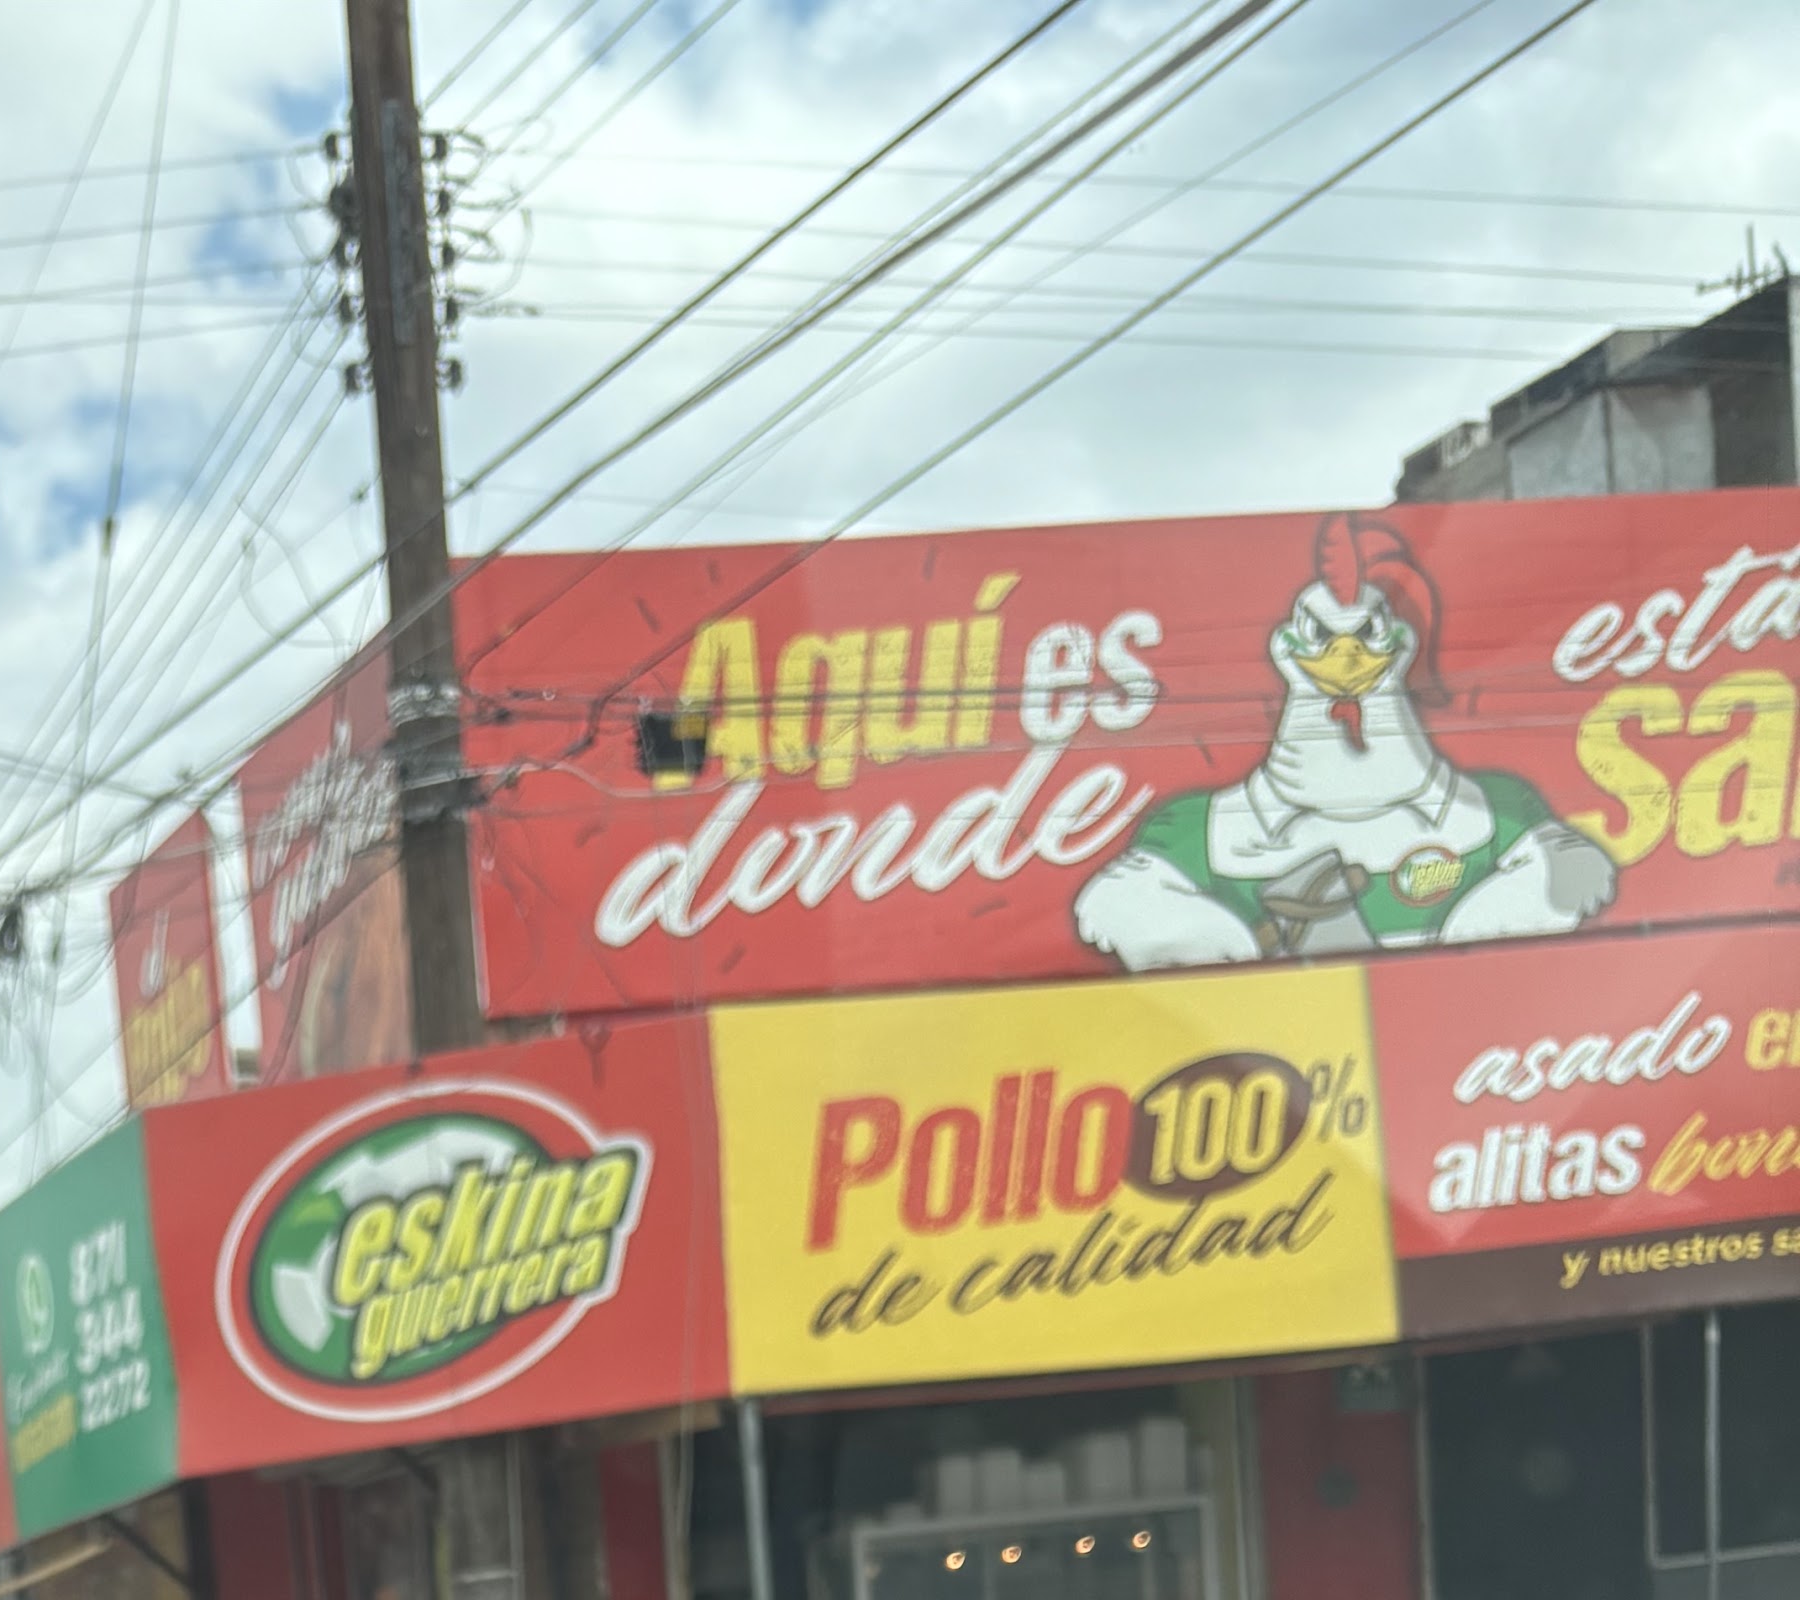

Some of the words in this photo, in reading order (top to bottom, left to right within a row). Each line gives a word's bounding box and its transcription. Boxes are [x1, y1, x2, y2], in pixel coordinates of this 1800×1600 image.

[650, 570, 1022, 792] Aquí
[1018, 610, 1164, 744] es
[594, 740, 1156, 948] donde
[1566, 668, 1800, 868] sa
[1452, 988, 1732, 1104] asado
[1743, 1006, 1800, 1072] e
[332, 1153, 637, 1308] eskina
[804, 1067, 1134, 1255] Pollo
[1428, 1121, 1646, 1213] alitas
[1647, 1111, 1800, 1197] bon
[74, 1284, 145, 1375] 344
[350, 1234, 609, 1381] guerrera
[807, 1246, 942, 1339] de
[945, 1166, 1337, 1316] calidad
[1558, 1249, 1591, 1290] y
[1597, 1230, 1764, 1277] nuestros
